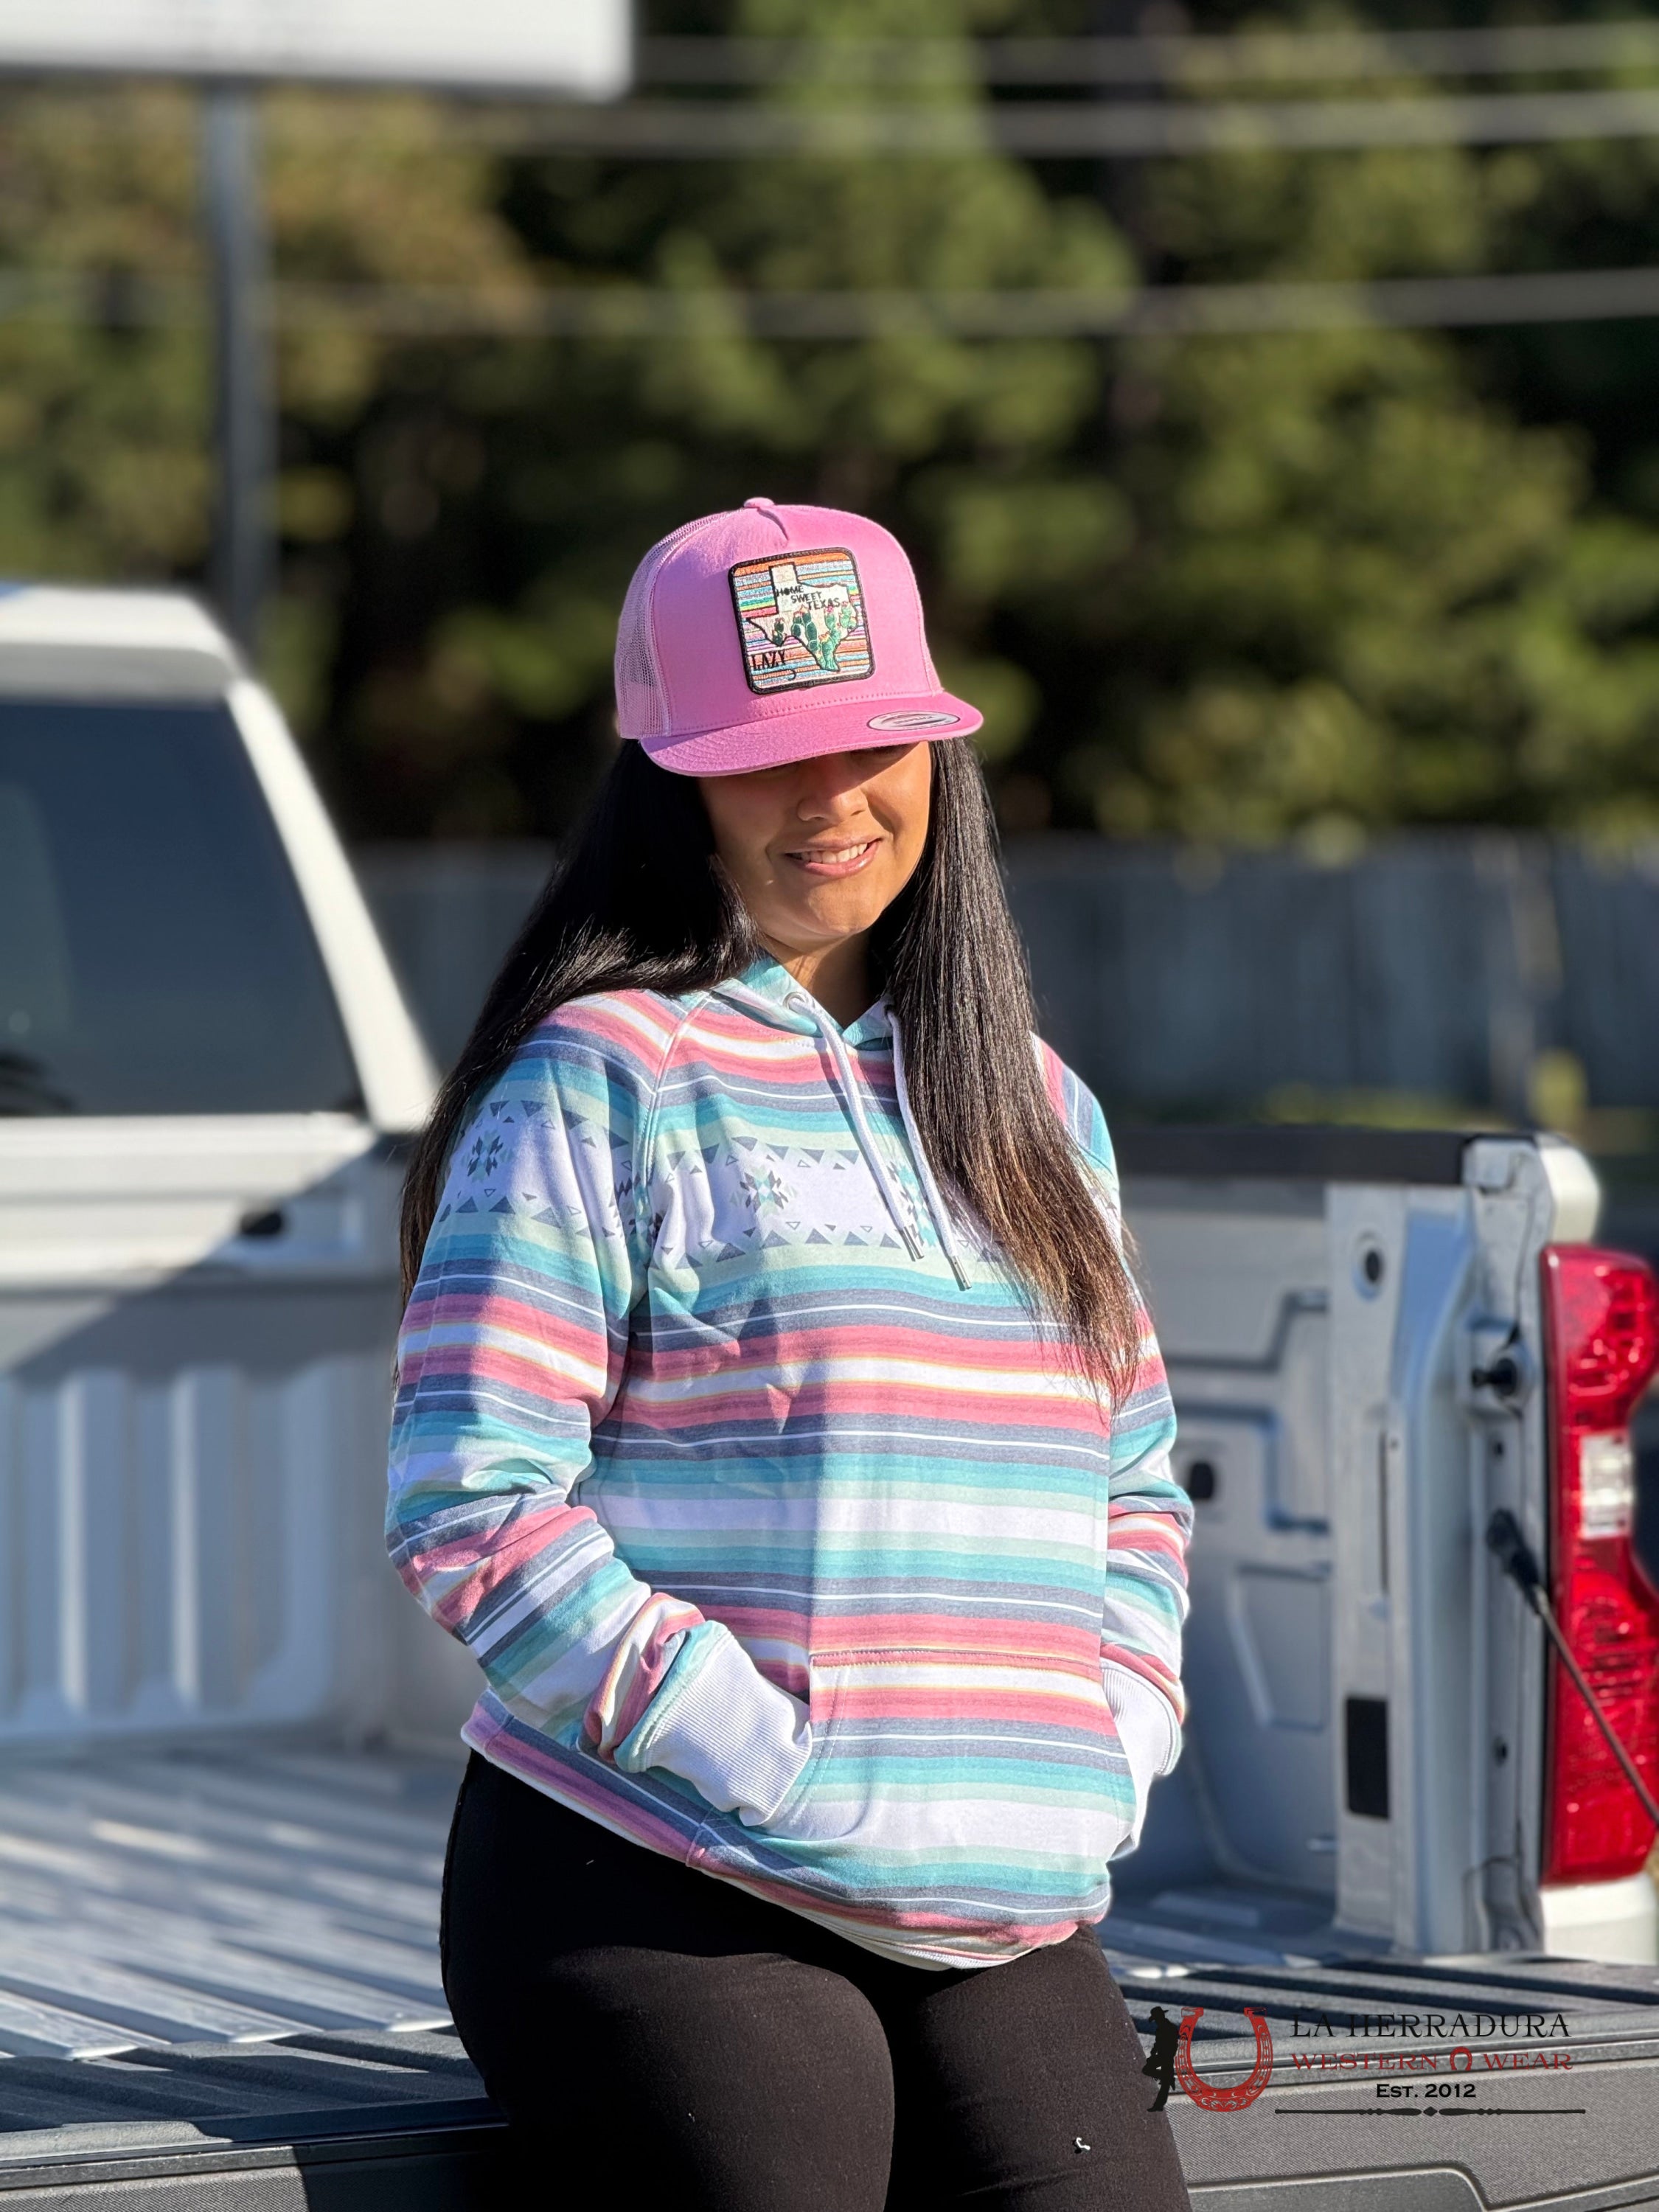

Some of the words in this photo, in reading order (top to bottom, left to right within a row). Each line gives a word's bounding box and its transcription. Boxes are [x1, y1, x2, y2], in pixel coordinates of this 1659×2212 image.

[776, 585, 804, 597] HOME
[790, 591, 822, 604] SWEET
[807, 597, 841, 611] TEXAS
[751, 649, 786, 670] LAZY
